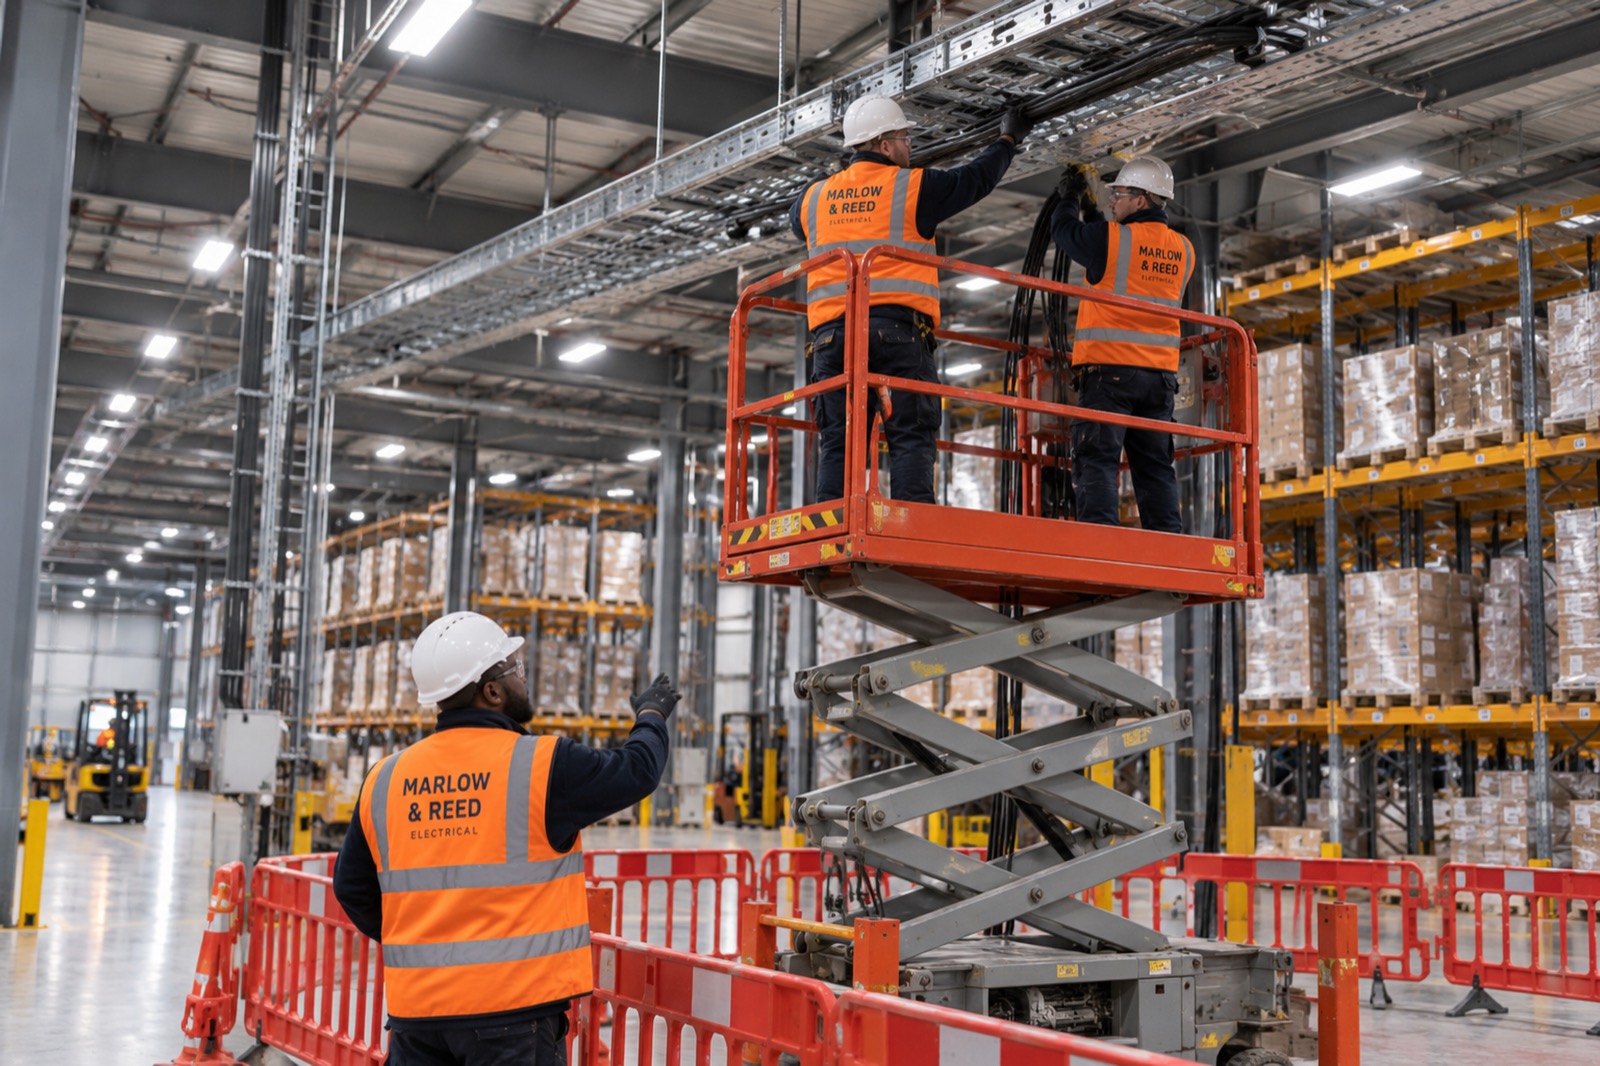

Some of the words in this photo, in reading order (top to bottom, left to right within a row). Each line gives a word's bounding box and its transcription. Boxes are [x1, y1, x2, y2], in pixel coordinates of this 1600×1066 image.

[827, 186, 882, 200] MARLOW
[829, 204, 838, 214] &
[842, 200, 876, 214] REED
[1139, 246, 1182, 262] MARLOW
[1141, 260, 1148, 271] &
[1152, 262, 1178, 275] REED
[403, 772, 491, 796] MARLOW
[408, 802, 422, 822] &
[429, 798, 481, 820] REED
[410, 826, 478, 840] ELECTRICAL
